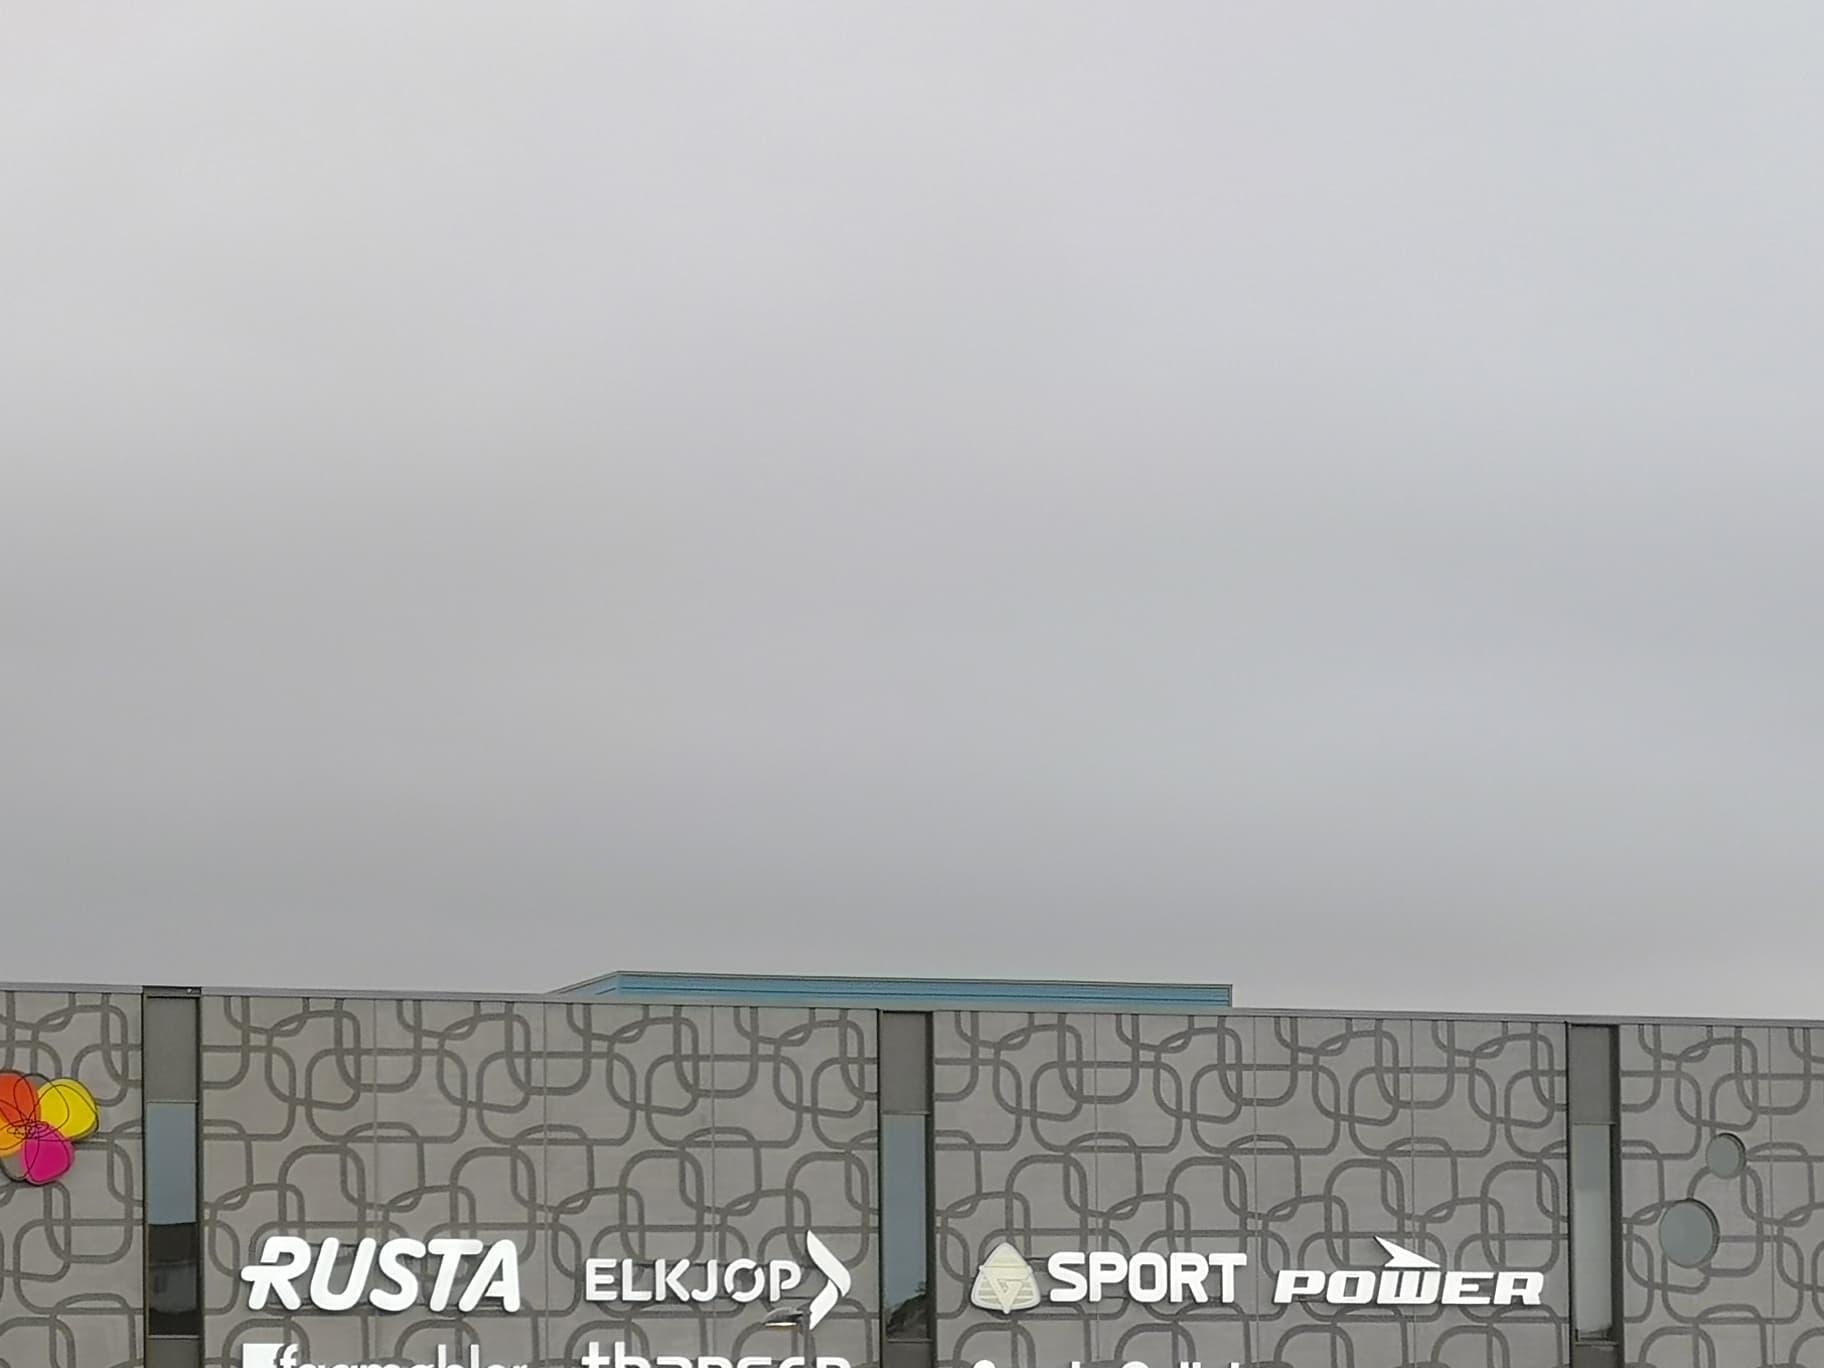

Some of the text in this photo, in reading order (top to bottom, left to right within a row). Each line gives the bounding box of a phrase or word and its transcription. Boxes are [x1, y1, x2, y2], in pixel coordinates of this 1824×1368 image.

[240, 1235, 522, 1312] RUSTA
[1047, 1251, 1248, 1303] SPORT
[1274, 1268, 1545, 1305] POWER
